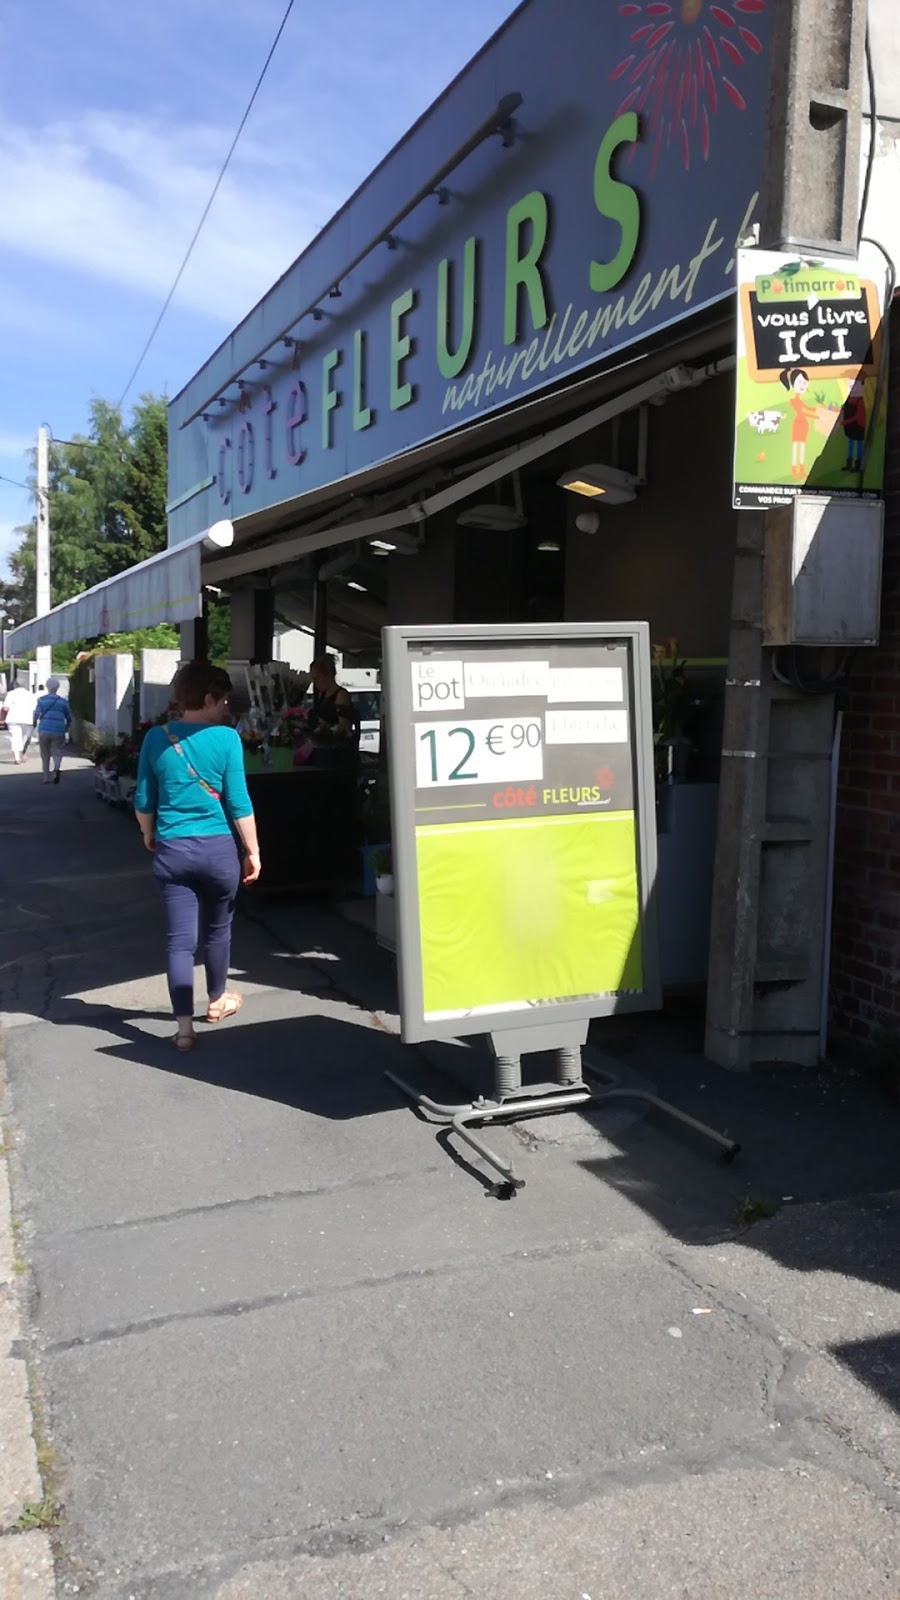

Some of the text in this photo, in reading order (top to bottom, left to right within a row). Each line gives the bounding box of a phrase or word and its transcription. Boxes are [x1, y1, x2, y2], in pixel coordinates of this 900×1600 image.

[321, 111, 641, 450] FLEURS
[761, 278, 856, 294] Potimarron
[757, 306, 867, 327] vous livre
[778, 328, 852, 363] ICI
[738, 486, 783, 495] COMMANDEZ
[758, 495, 792, 504] VOS PROD
[418, 664, 435, 679] Le
[417, 678, 460, 708] pot
[492, 784, 537, 808] côté
[543, 786, 600, 804] FLEURS
